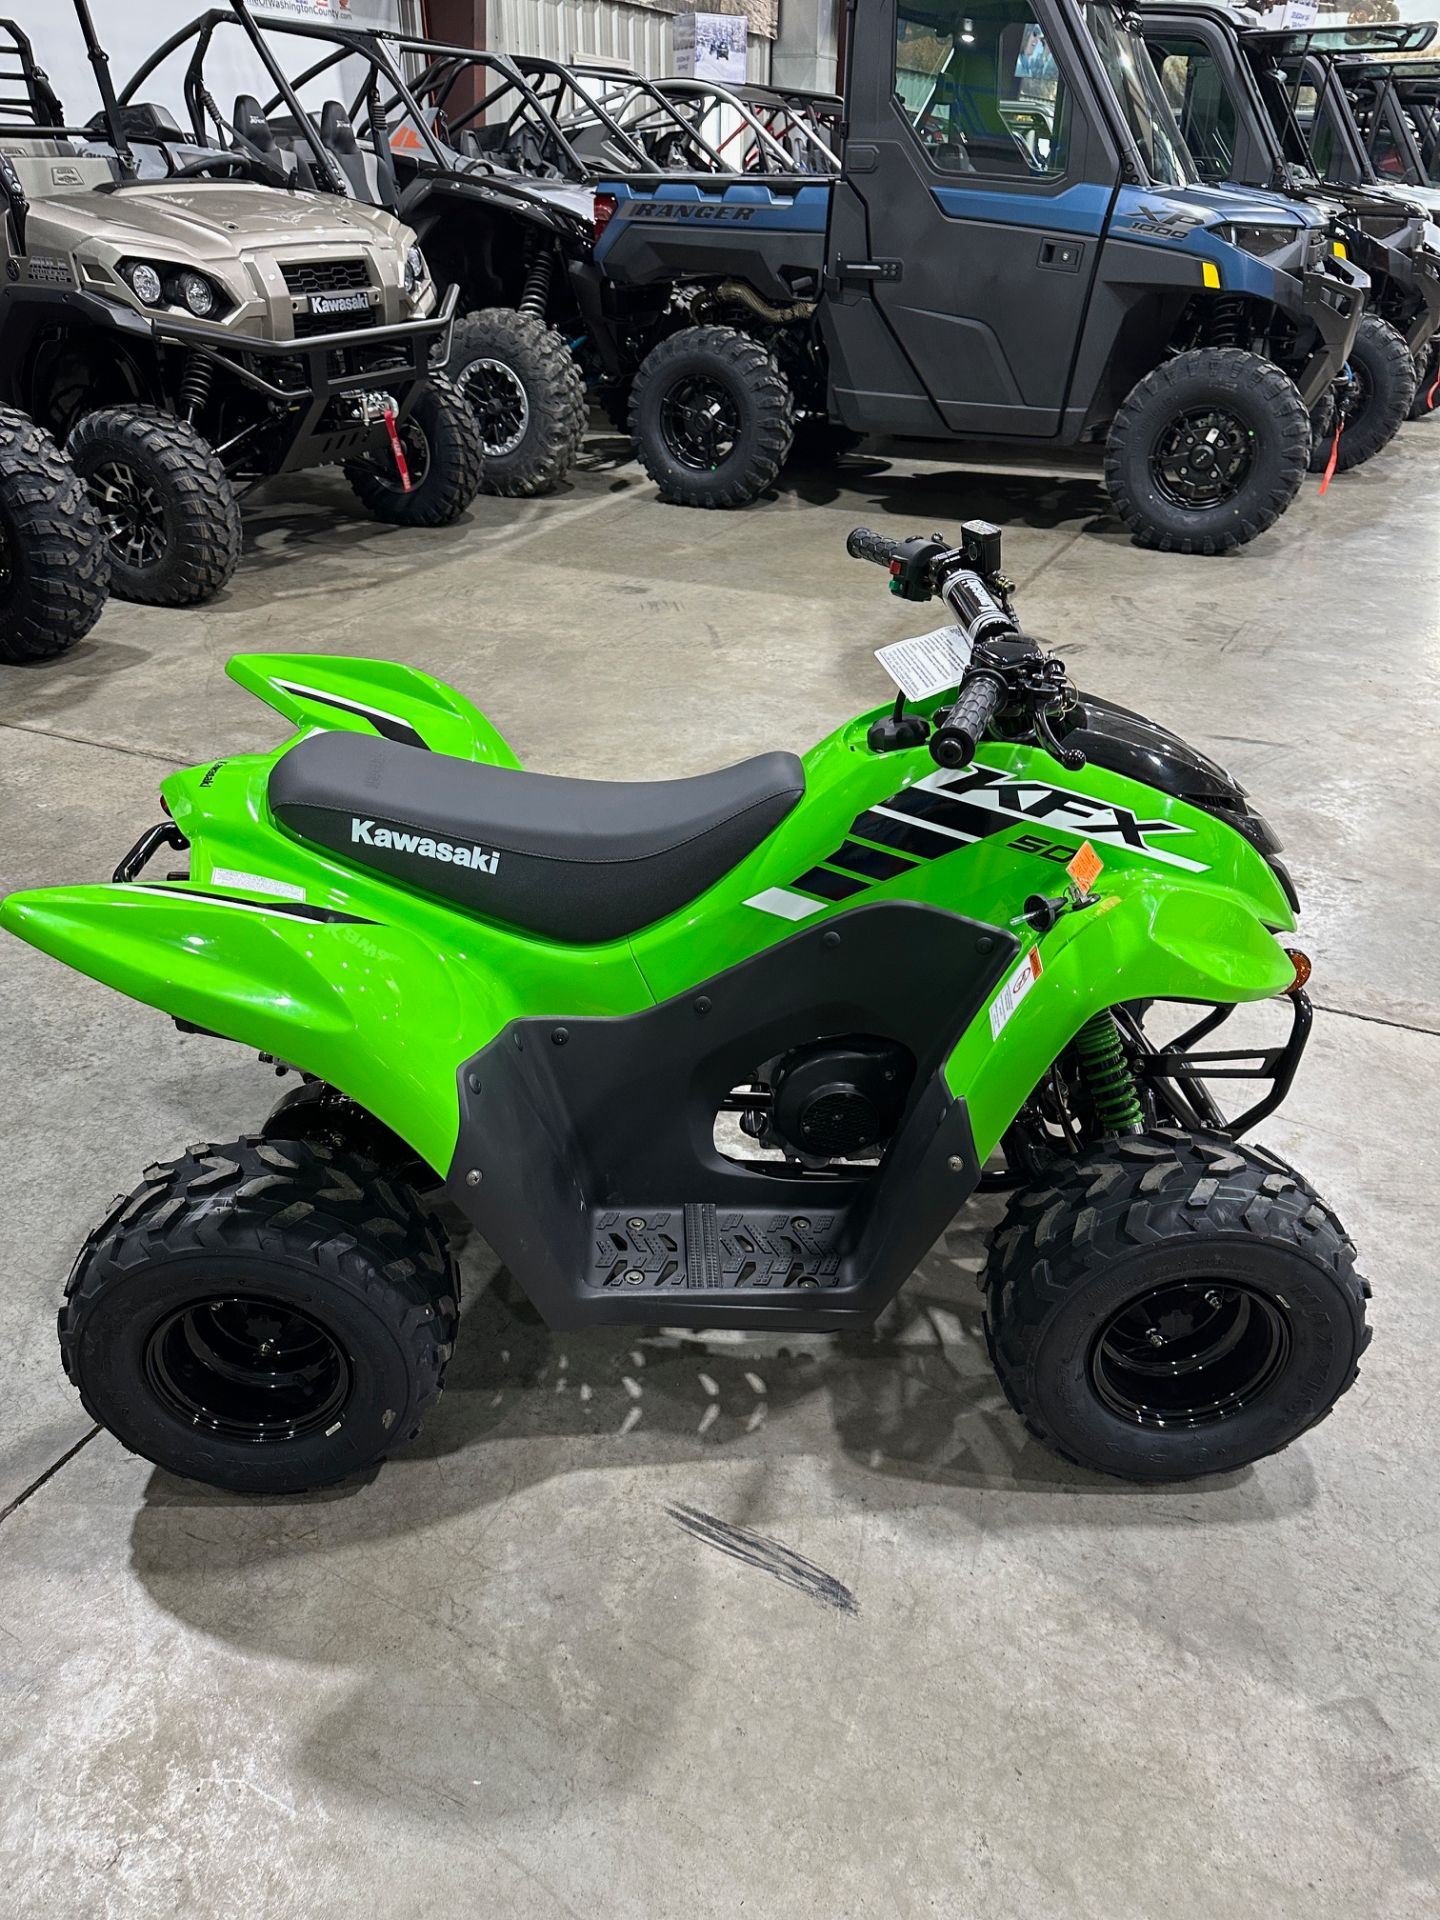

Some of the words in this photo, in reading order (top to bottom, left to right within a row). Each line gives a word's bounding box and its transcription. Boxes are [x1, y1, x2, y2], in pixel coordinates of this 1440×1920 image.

[632, 203, 756, 221] RANGER
[1124, 204, 1205, 226] XP
[1131, 222, 1190, 239] 1000
[311, 292, 369, 314] Kawasaki
[936, 765, 1182, 852] KFX
[351, 817, 501, 875] Kawasaki
[1005, 834, 1077, 863] 50
